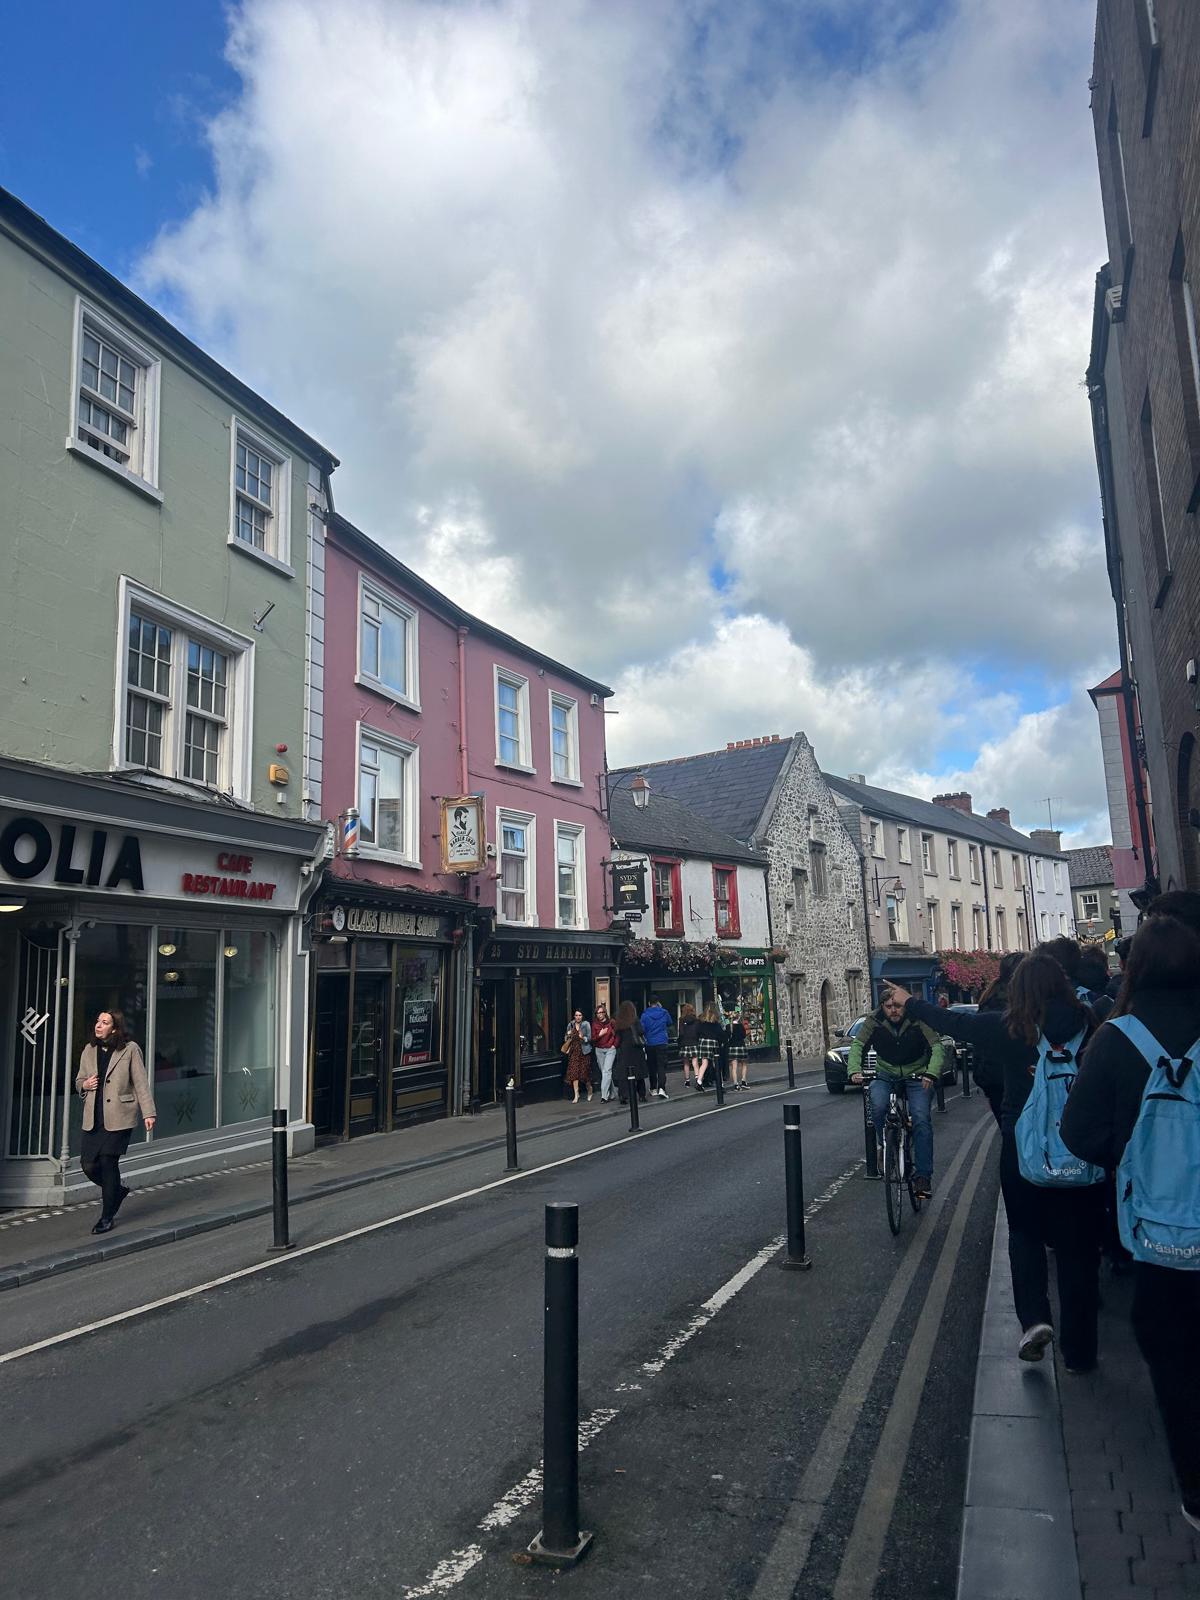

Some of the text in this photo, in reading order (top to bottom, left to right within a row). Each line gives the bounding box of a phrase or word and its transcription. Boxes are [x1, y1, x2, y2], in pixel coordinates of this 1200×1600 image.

[0, 817, 144, 891] OLIA
[217, 852, 253, 874] CAFE
[182, 873, 277, 900] RESTAURANT
[347, 909, 439, 937] CLASS BARBER SHOP
[517, 944, 540, 959] SYD
[546, 946, 592, 960] HARKINS
